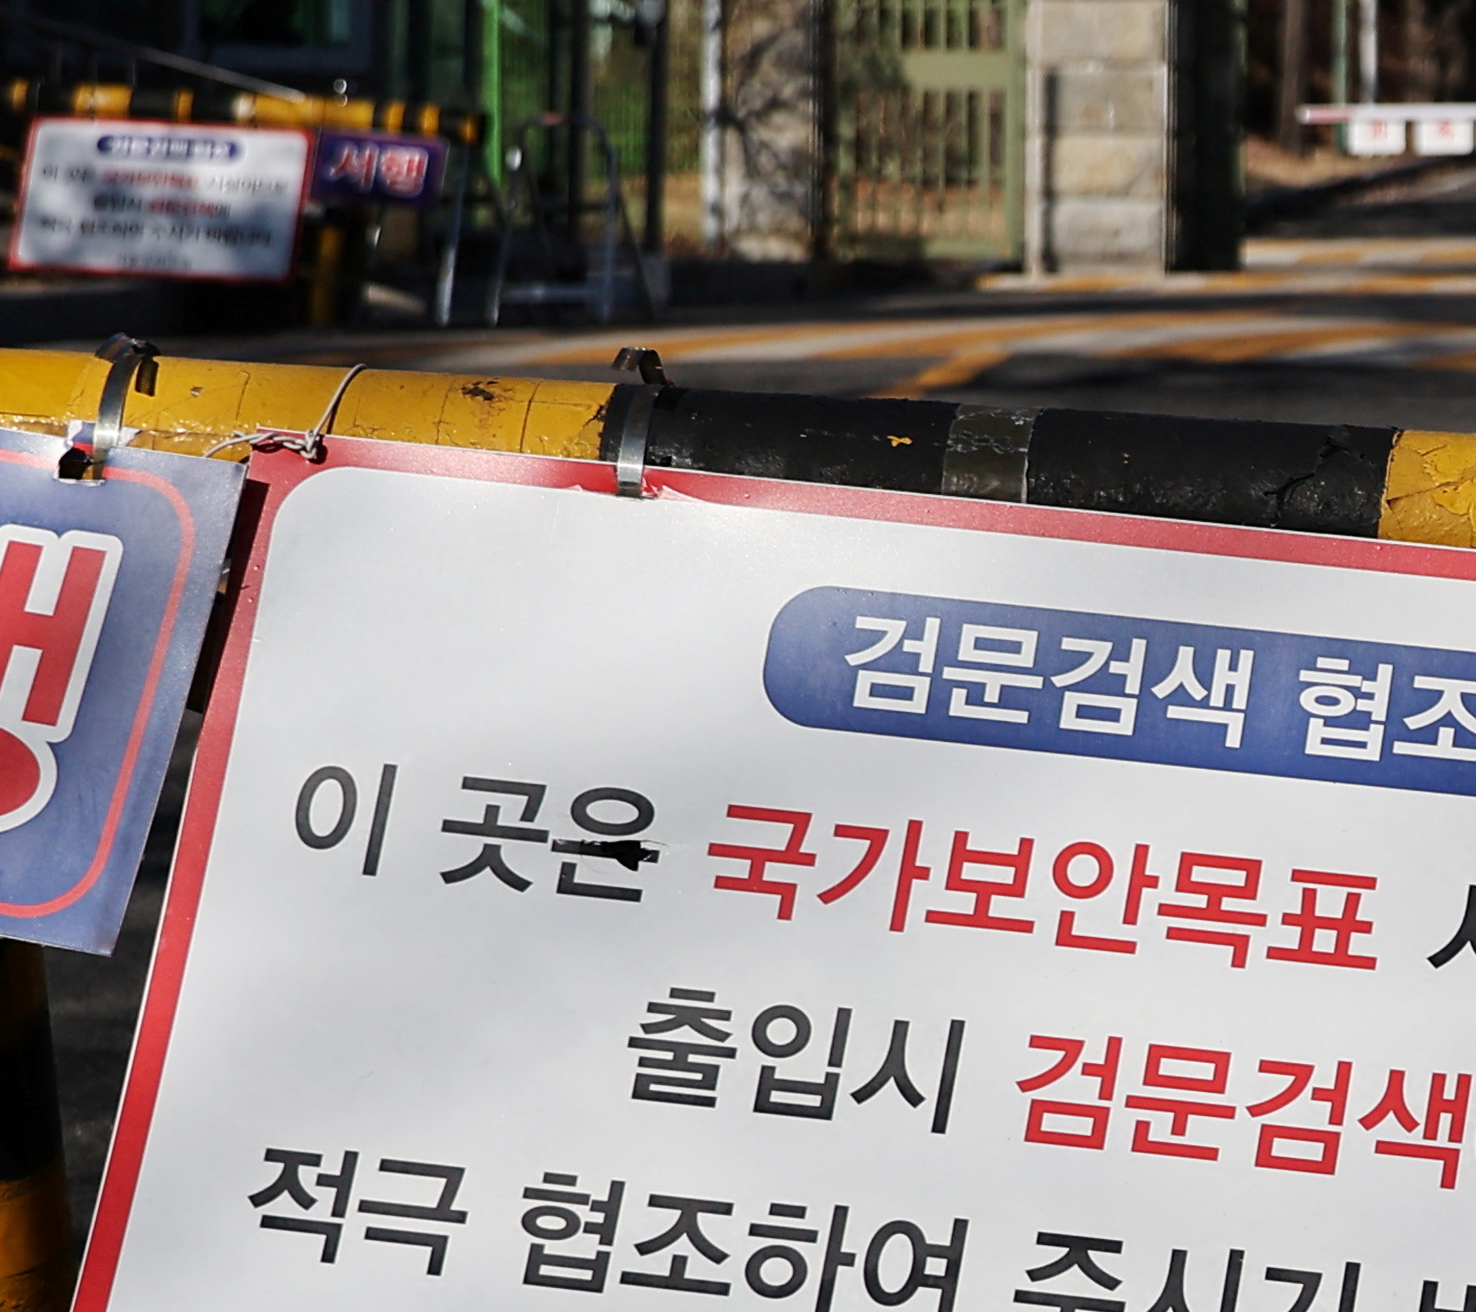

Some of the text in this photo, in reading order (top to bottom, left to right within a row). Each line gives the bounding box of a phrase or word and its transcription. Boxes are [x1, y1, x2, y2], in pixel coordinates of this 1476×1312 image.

[844, 614, 1255, 749] 검문검색
[295, 763, 398, 877] 이
[439, 776, 661, 903] 곳은
[707, 804, 1378, 971] 국가보안목표
[627, 987, 966, 1135] 출입시
[247, 1147, 468, 1277] 적극
